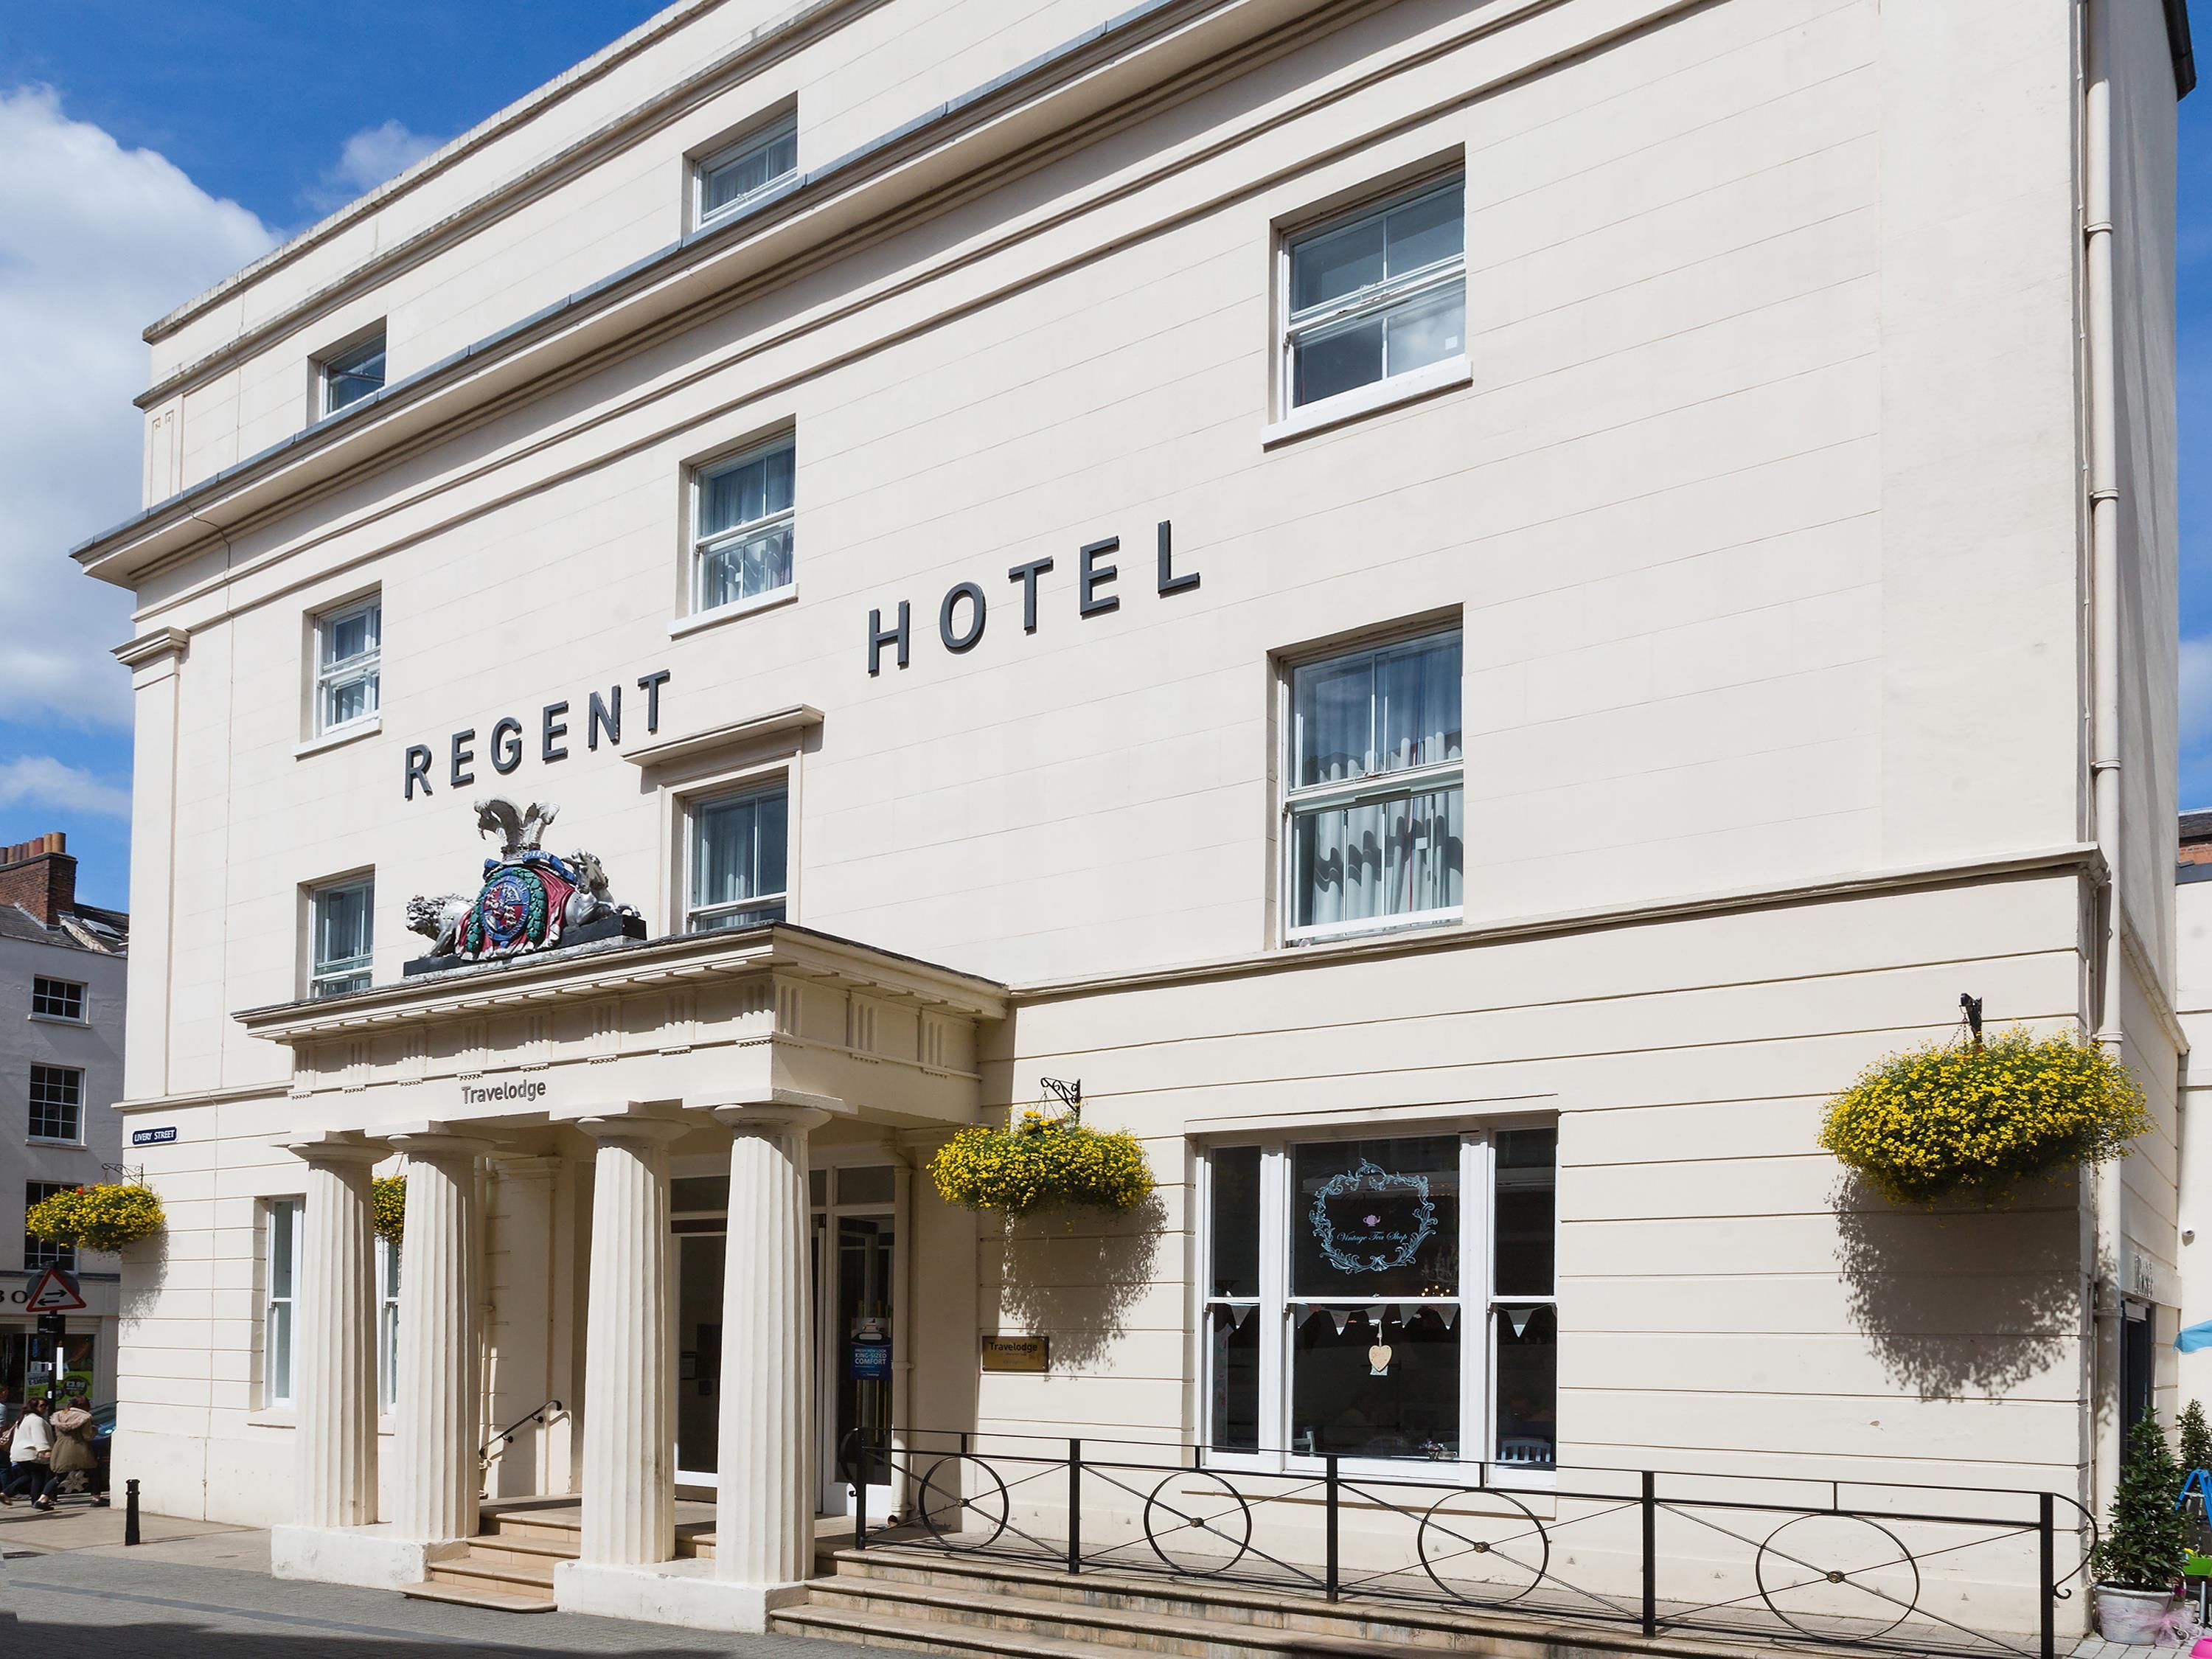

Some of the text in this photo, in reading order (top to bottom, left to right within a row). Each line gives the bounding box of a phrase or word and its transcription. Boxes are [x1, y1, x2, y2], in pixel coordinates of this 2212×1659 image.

[405, 519, 1200, 801] REGENT HOTEL
[461, 1079, 546, 1104] Travelodge
[134, 1129, 175, 1142] LIVERY STREET
[1337, 1231, 1408, 1245] Vintage Tea Shop
[989, 1342, 1038, 1353] Travelodge
